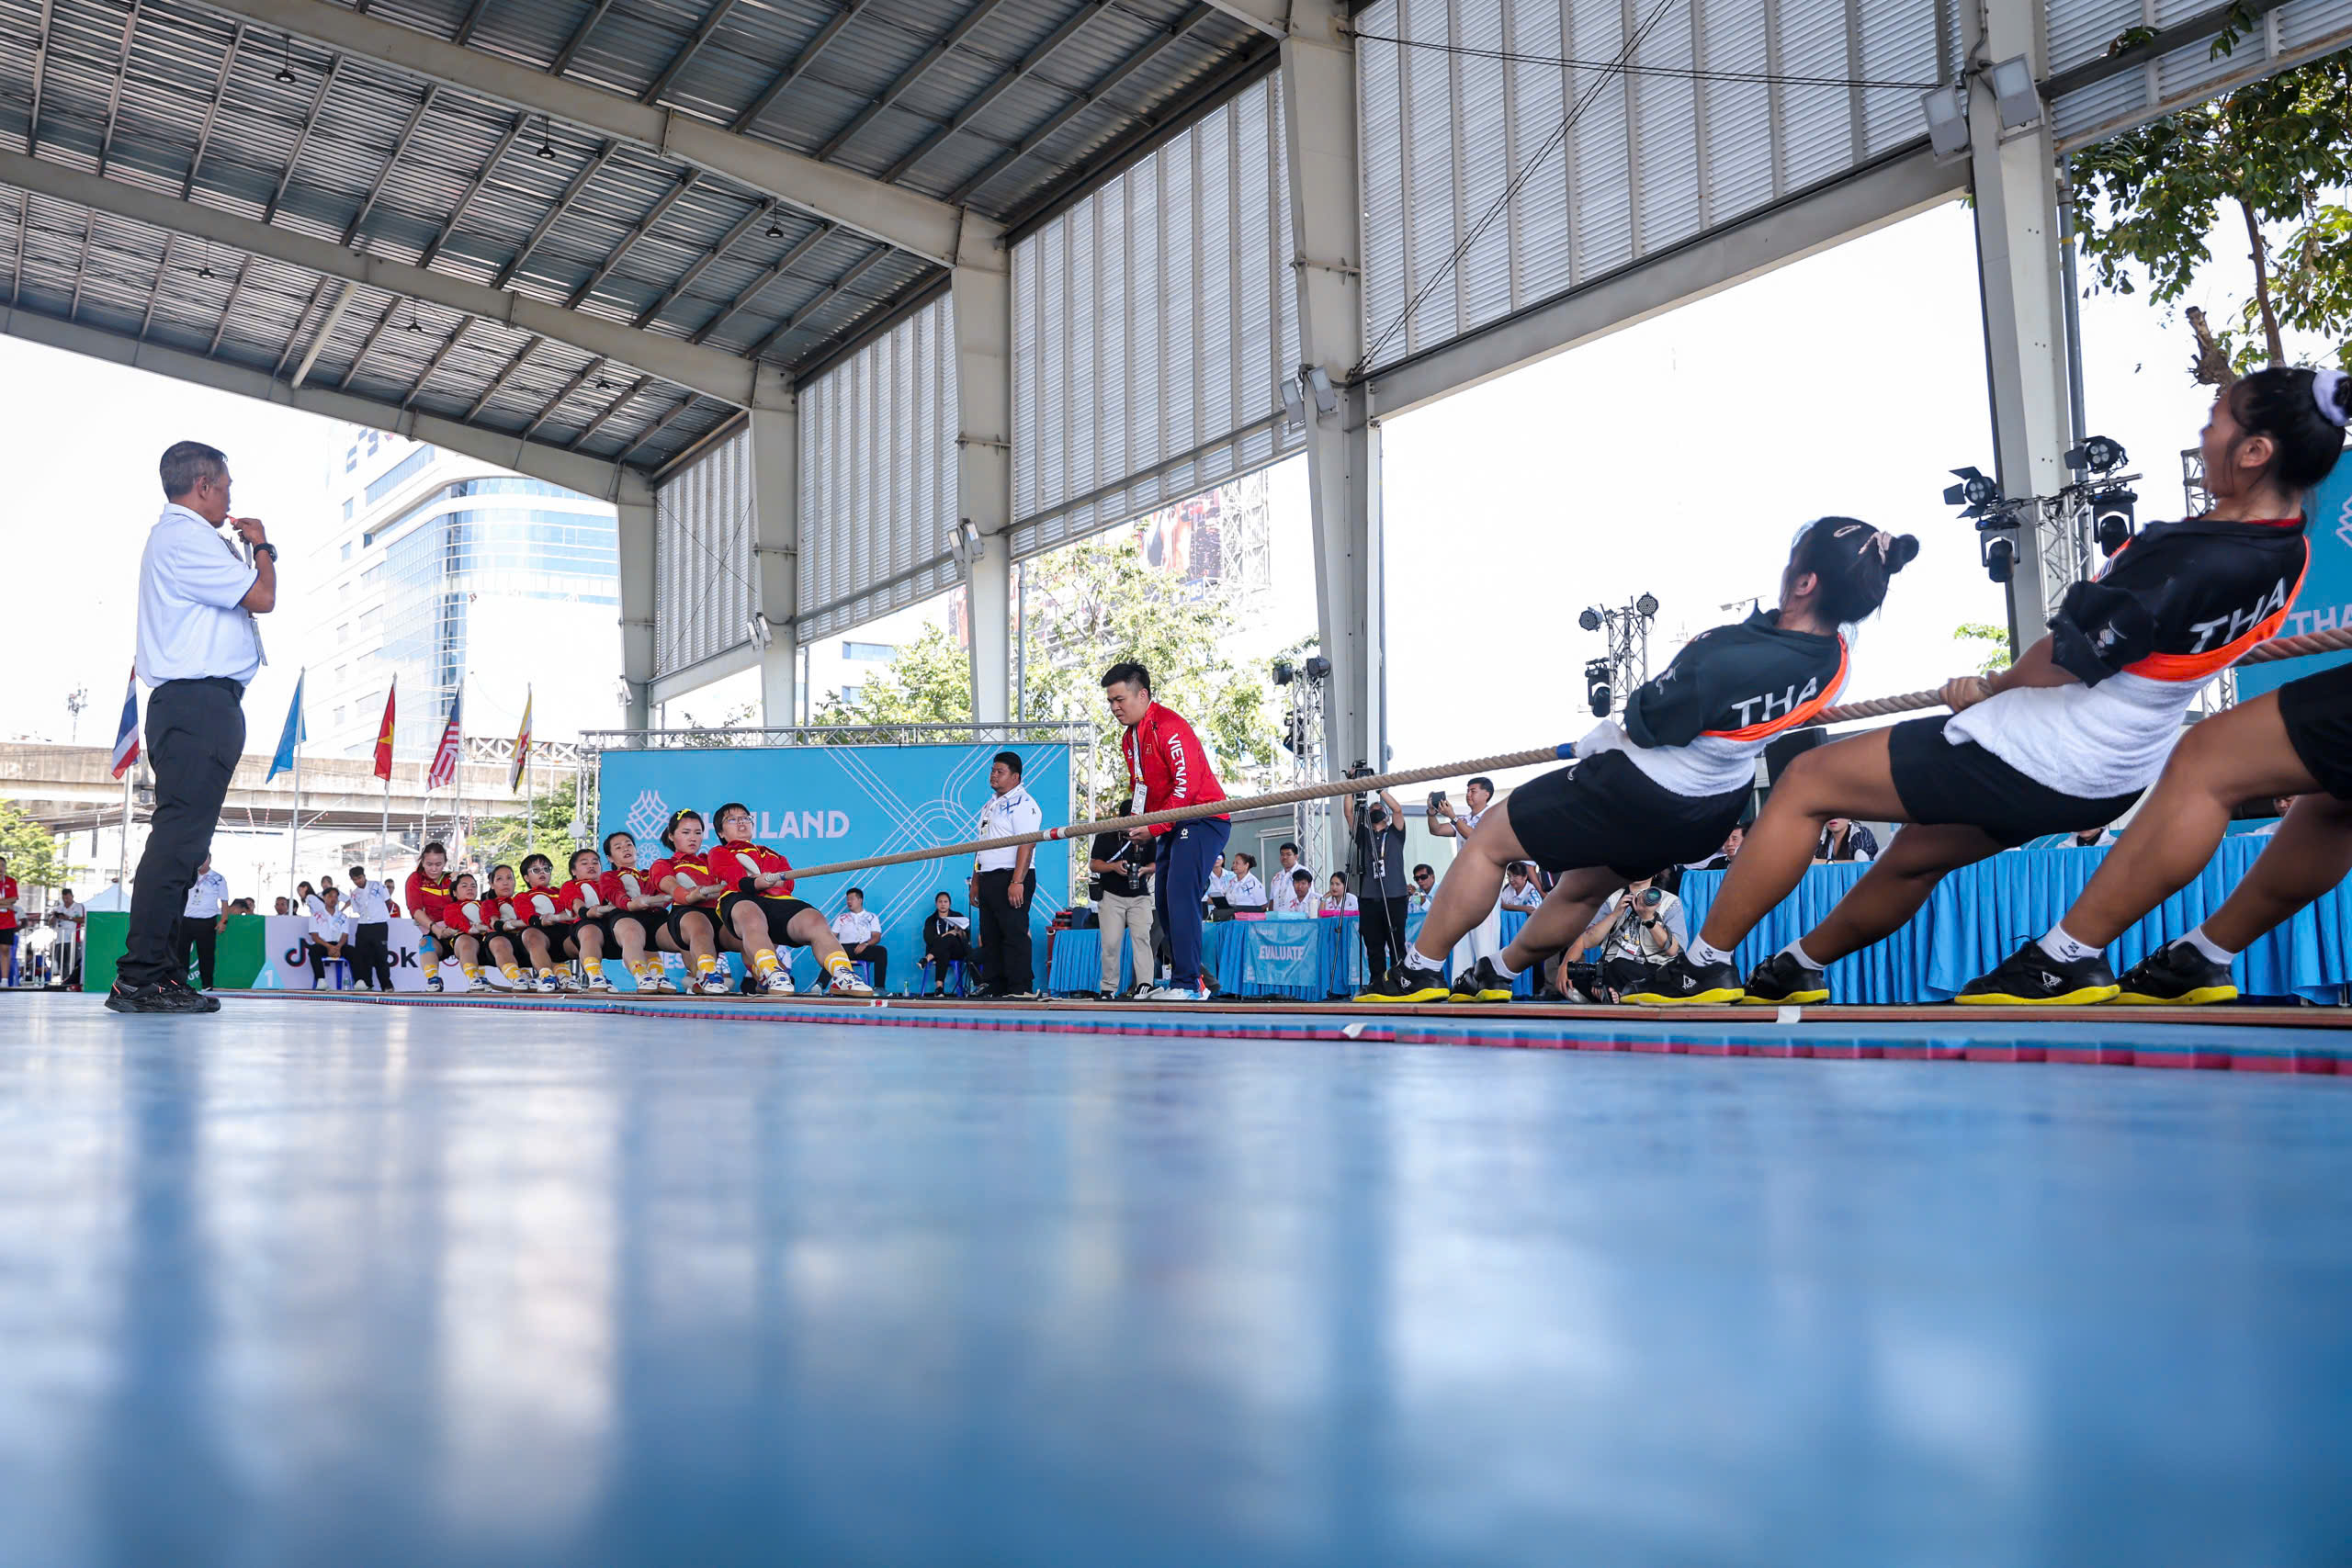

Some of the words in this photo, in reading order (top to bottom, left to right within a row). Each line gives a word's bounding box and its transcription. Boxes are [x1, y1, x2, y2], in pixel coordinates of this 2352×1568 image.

[2188, 577, 2286, 654] THA
[1730, 676, 1817, 728] THA
[1168, 733, 1188, 799] VIETNAM
[1257, 944, 1306, 961] EVALUATE
